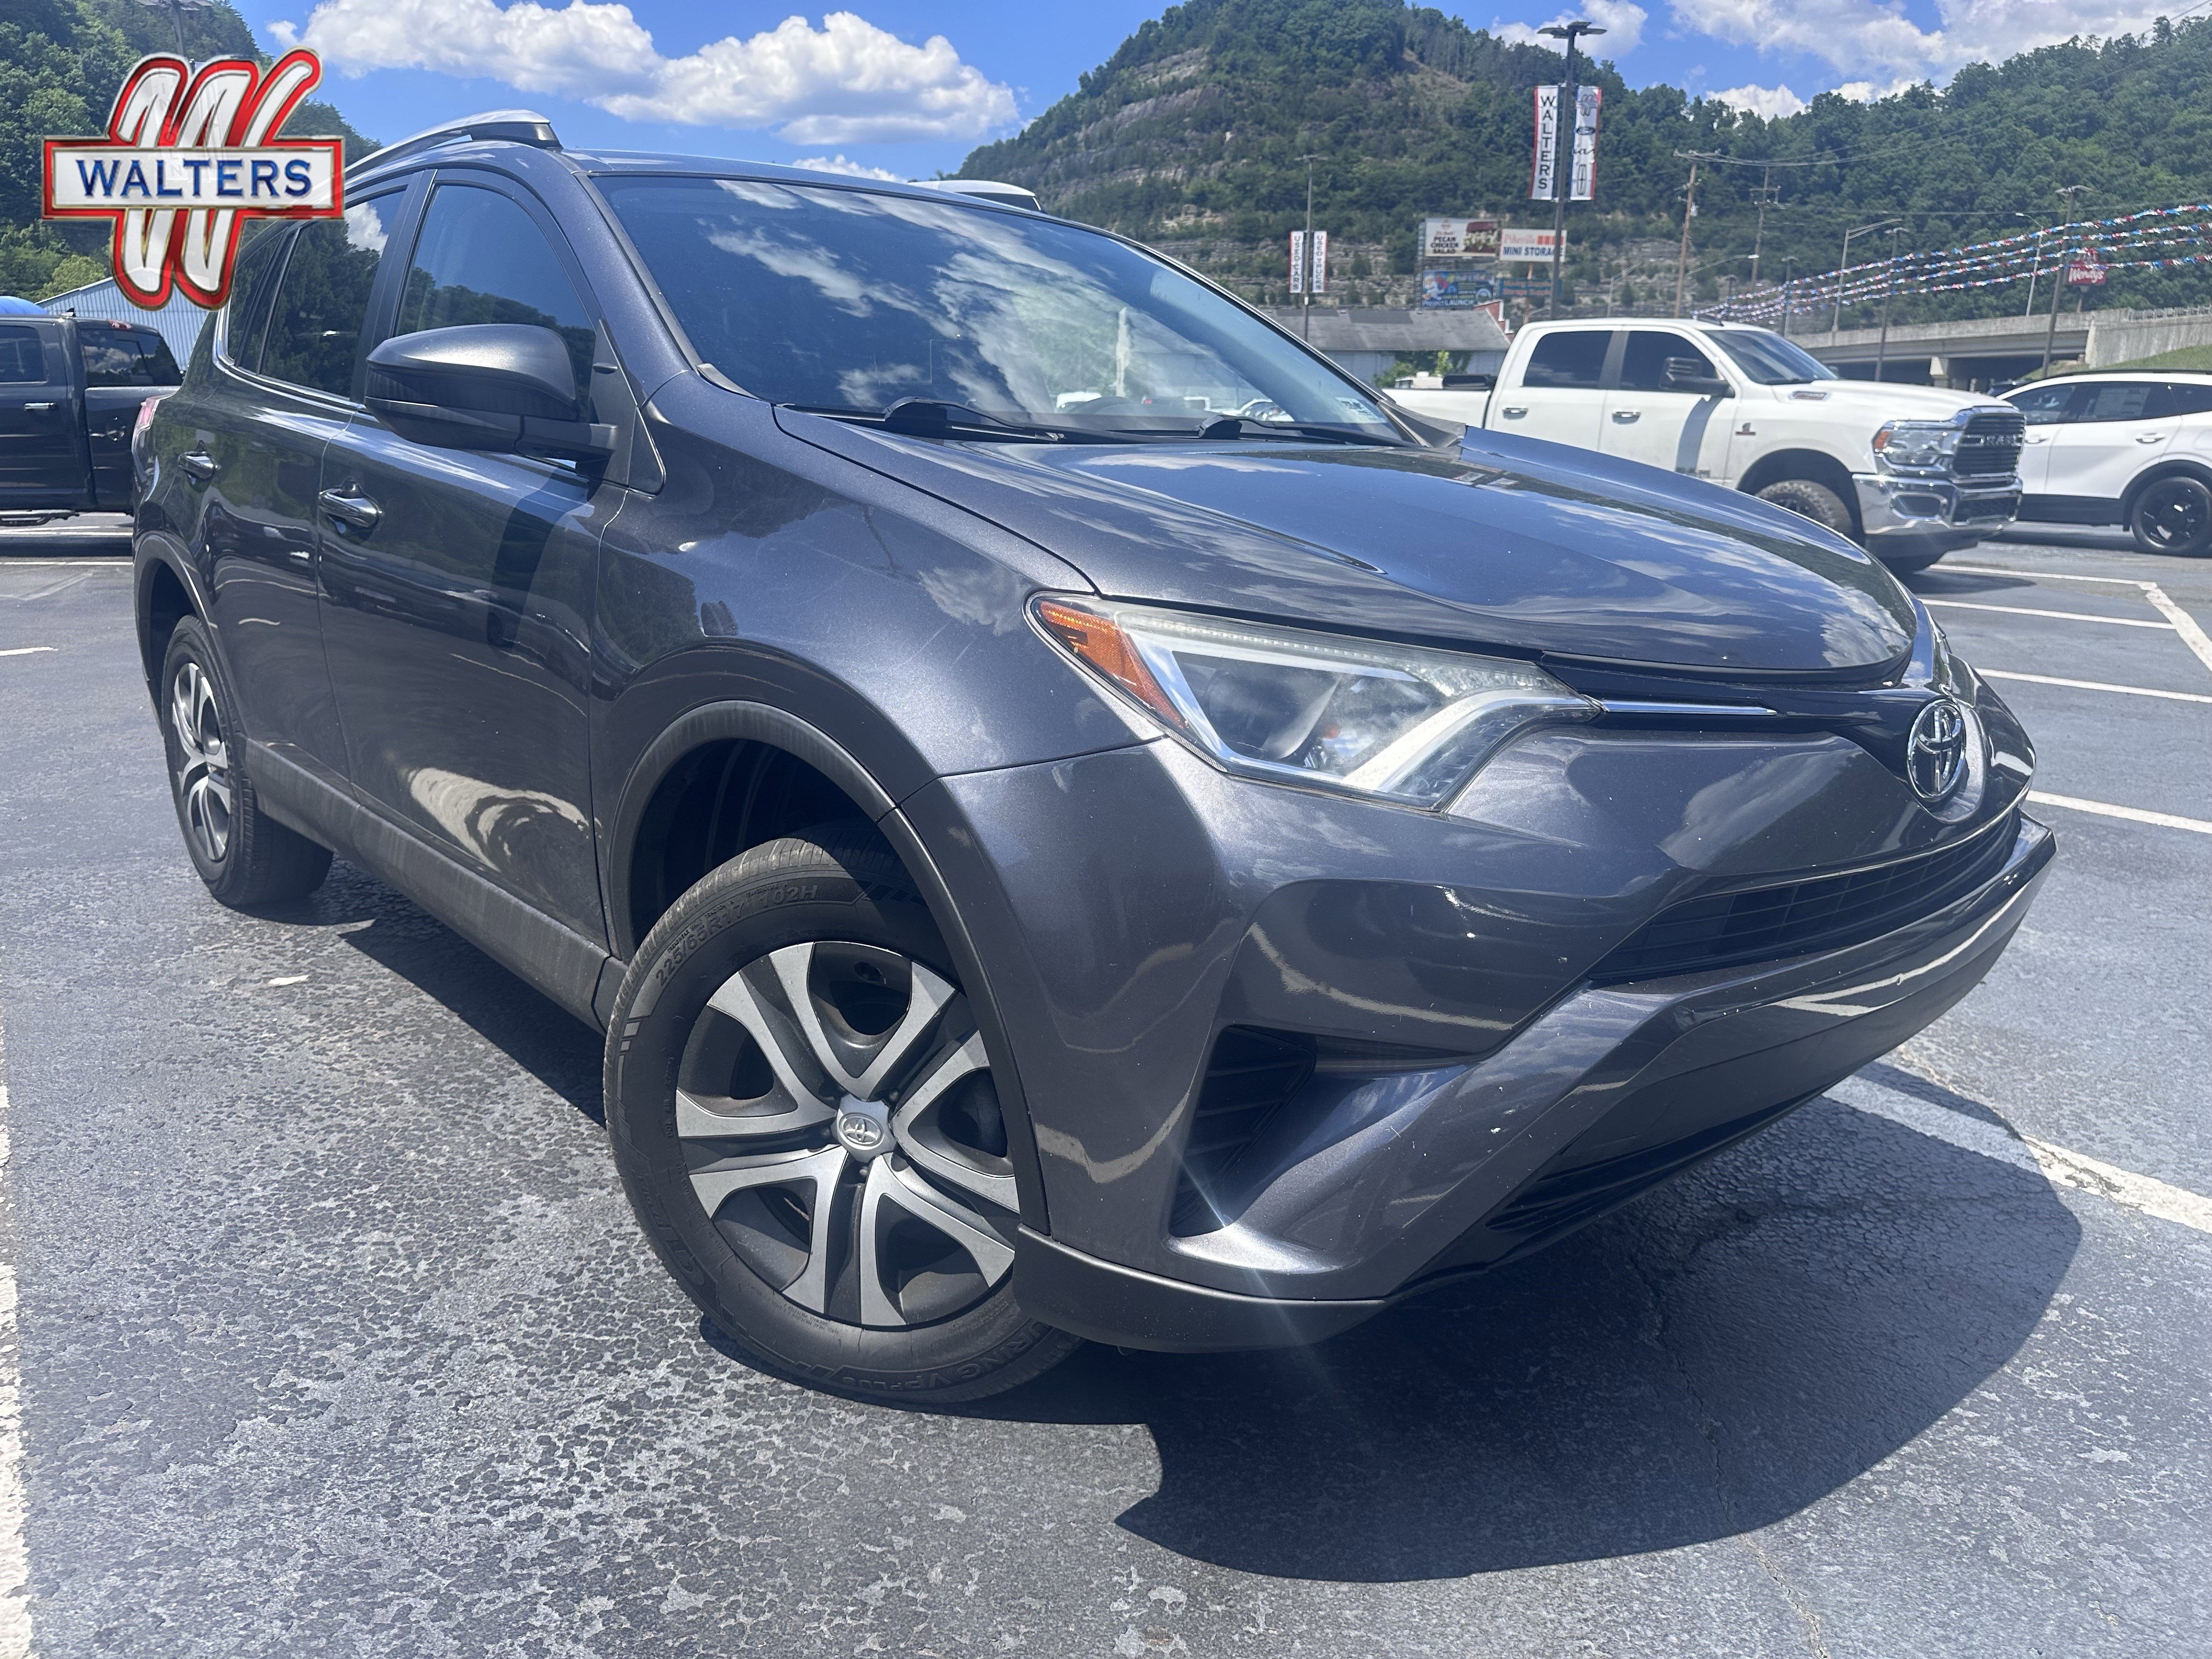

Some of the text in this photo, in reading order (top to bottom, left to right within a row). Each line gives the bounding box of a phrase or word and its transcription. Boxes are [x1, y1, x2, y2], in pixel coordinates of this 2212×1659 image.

[1538, 95, 1556, 190] WALTERS
[1504, 246, 1563, 256] MINI STORAE
[656, 884, 820, 987] 225/65R17 102H
[956, 1321, 1051, 1380] URING
